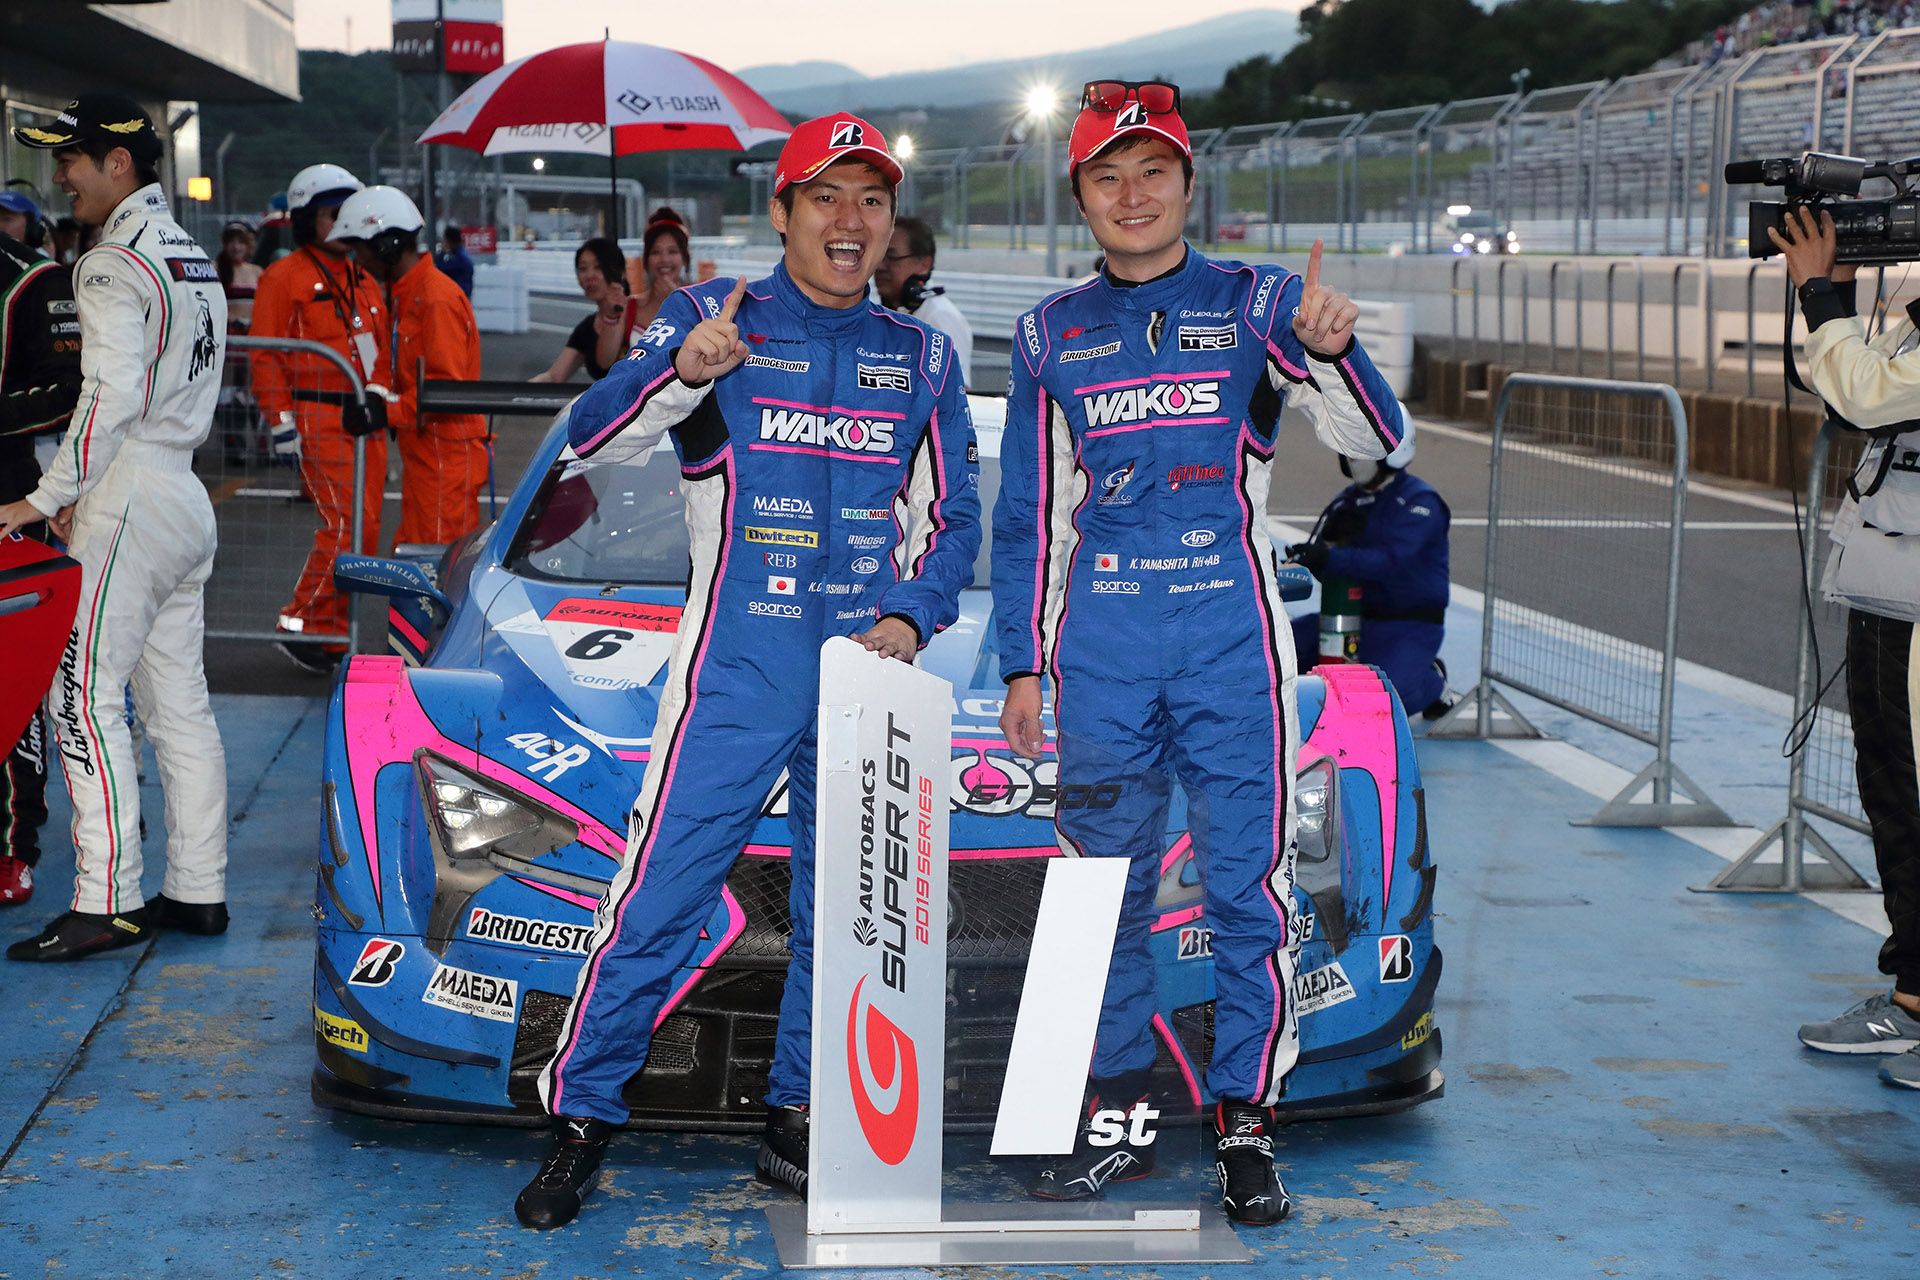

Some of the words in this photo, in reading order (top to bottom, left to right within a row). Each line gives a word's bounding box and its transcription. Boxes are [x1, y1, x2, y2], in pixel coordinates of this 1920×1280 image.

[652, 95, 721, 111] T-DASH
[1252, 274, 1277, 317] sparco
[1191, 310, 1222, 318] LEXUS
[1023, 313, 1041, 357] sparco
[1181, 335, 1233, 349] TRD
[745, 355, 808, 372] BRIDGESTONE
[865, 351, 895, 360] LEXUS
[928, 333, 943, 375] sparco
[1060, 342, 1119, 362] BRIDGESTONE
[860, 374, 907, 388] TRD
[1083, 381, 1221, 428] WAKO'S
[759, 407, 895, 453] WAKO'S
[753, 495, 814, 514] MAEDA
[340, 560, 380, 572] FRANCK
[385, 562, 420, 586] MULLER
[763, 552, 797, 568] REB
[1091, 580, 1141, 594] sparco
[1168, 583, 1193, 594] Team
[748, 600, 802, 618] sparco
[565, 629, 634, 660] 6
[505, 732, 591, 783] 4CR
[886, 711, 911, 794] GT
[859, 758, 877, 914] AUTOBACS
[917, 775, 934, 877] SERIES
[881, 800, 910, 994] SUPER
[915, 877, 930, 945] 2019
[431, 968, 514, 1008] MAEDA
[437, 995, 460, 1008] SHELL
[461, 1001, 485, 1013] SERVICE
[490, 1008, 512, 1018] GIKEN
